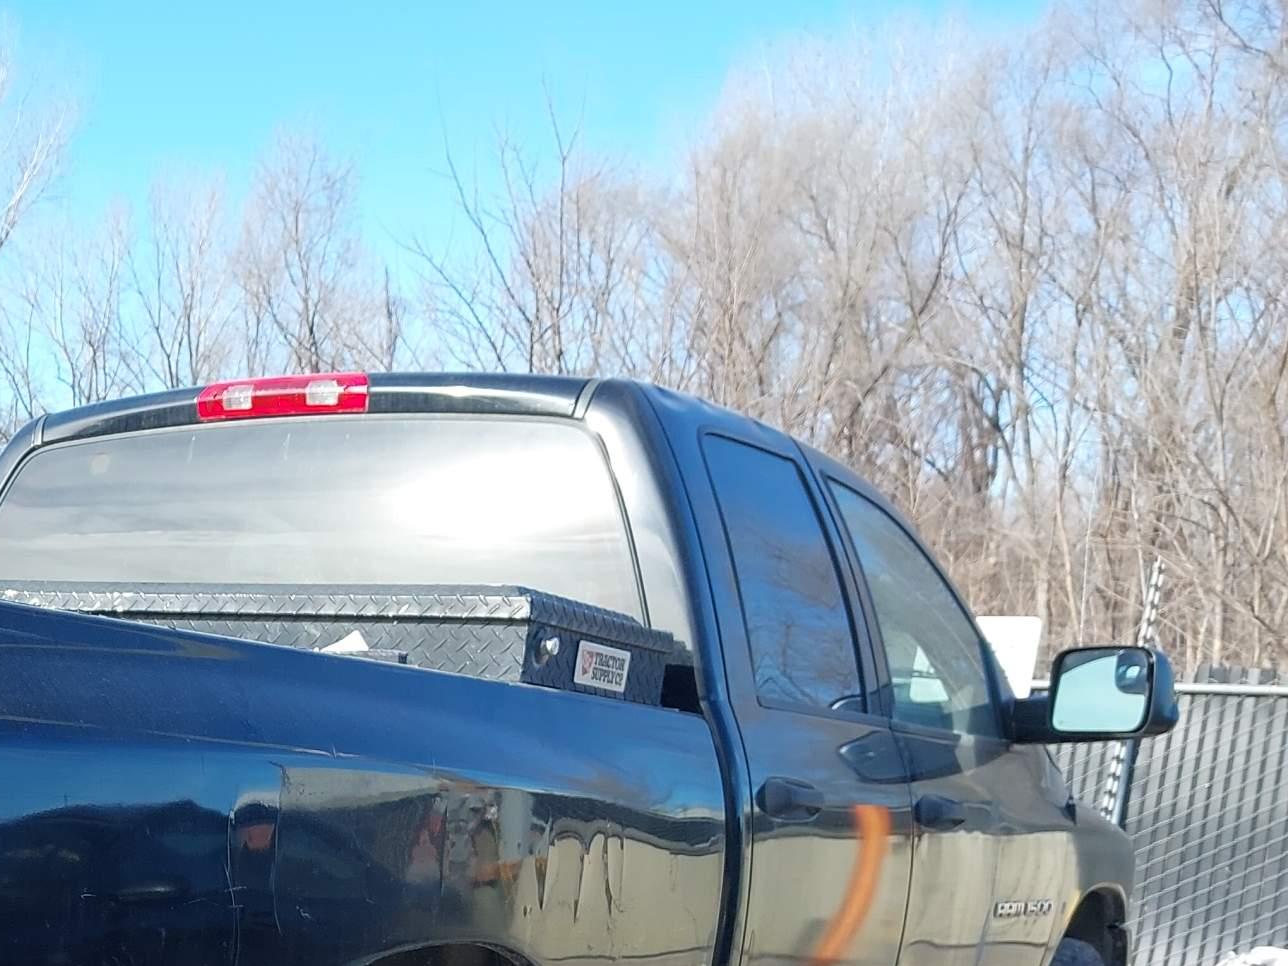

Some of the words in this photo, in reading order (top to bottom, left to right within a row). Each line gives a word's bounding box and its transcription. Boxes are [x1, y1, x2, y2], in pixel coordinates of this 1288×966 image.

[594, 652, 626, 671] TRACTOR
[591, 667, 616, 685] SUPPLY
[994, 901, 1024, 917] RAM
[1025, 899, 1054, 916] 1500
